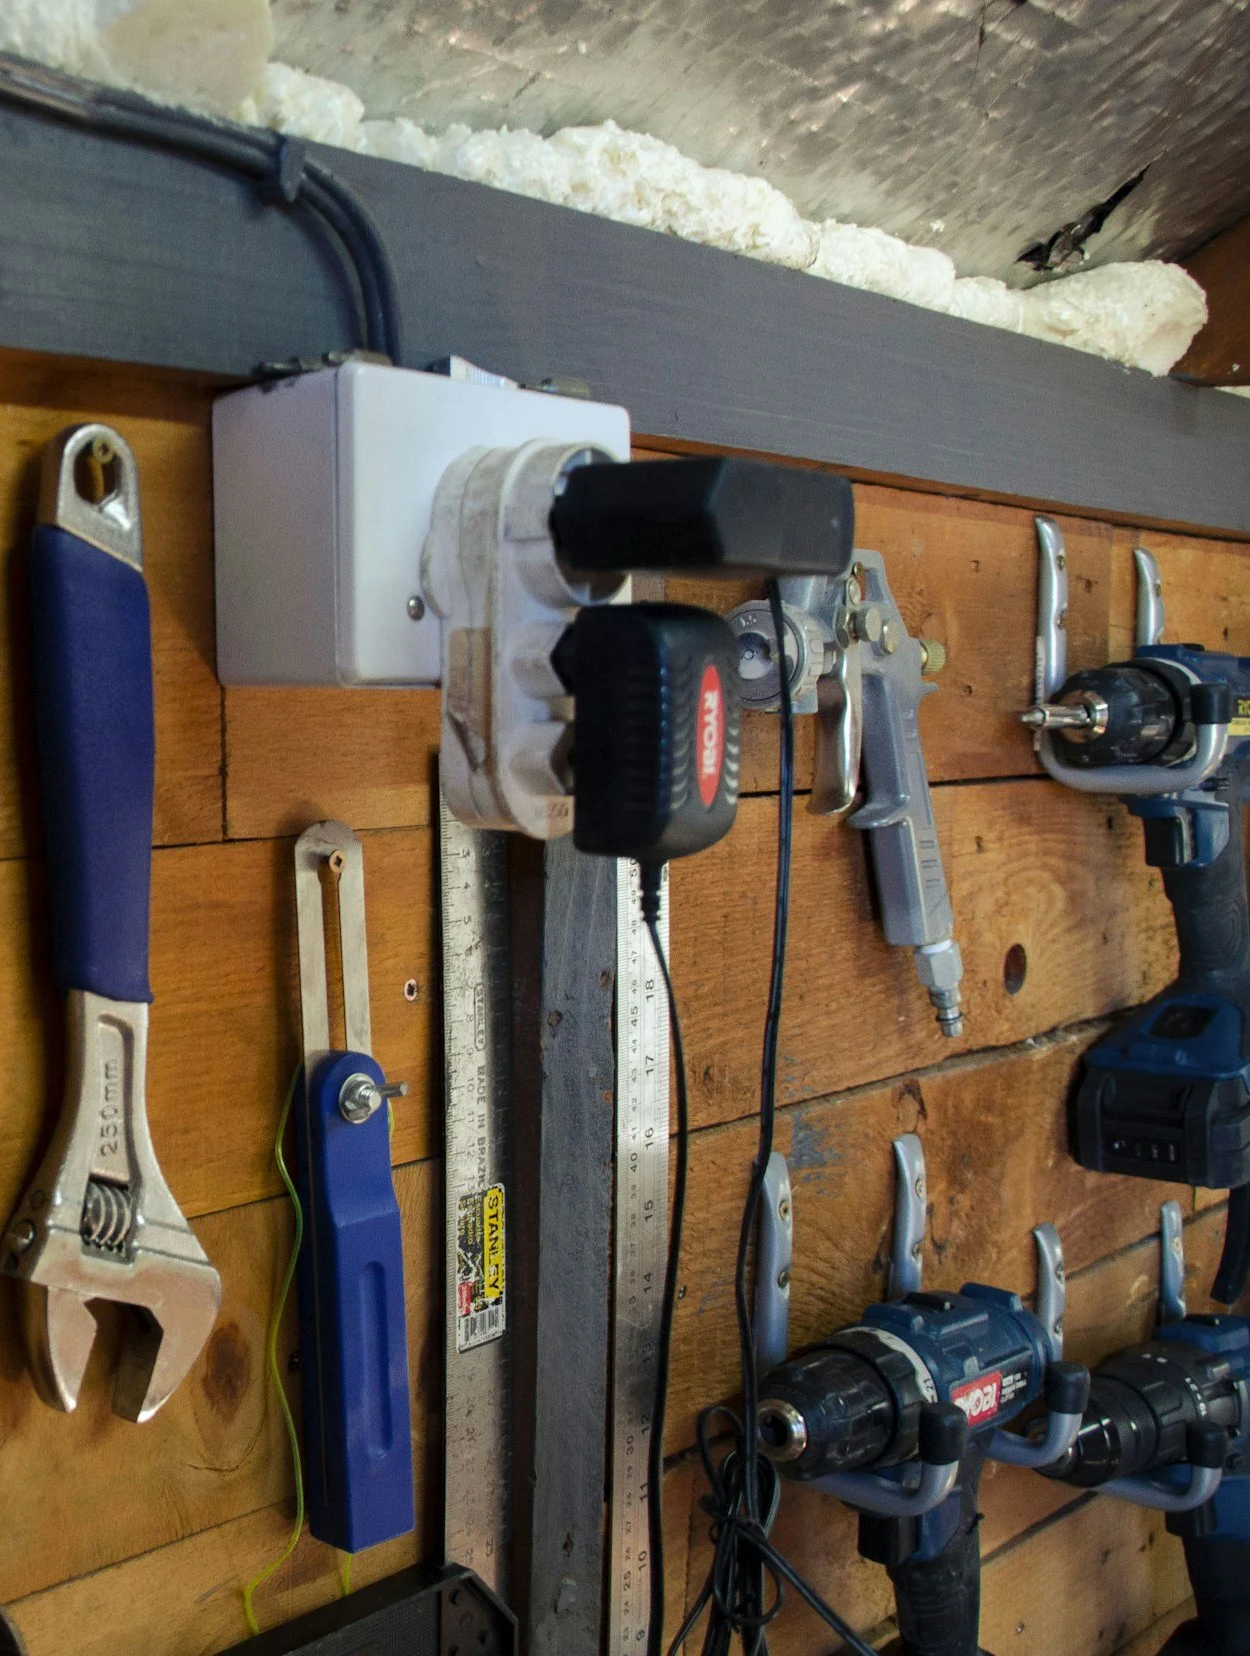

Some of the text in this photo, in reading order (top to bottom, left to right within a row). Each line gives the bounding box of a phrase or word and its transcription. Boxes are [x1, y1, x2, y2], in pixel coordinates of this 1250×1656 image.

[702, 690, 718, 779] RYOBI
[631, 951, 637, 965] 47
[645, 978, 655, 1002] 18
[630, 1005, 639, 1027] 45
[645, 1054, 654, 1077] 17
[476, 1065, 486, 1104] MADE
[99, 1059, 119, 1158] 250mm
[631, 1096, 638, 1112] 42
[477, 1114, 486, 1129] IN
[631, 1127, 637, 1141] 41
[644, 1127, 654, 1149] 16
[630, 1152, 638, 1173] 40
[644, 1199, 654, 1222] 15
[487, 1194, 500, 1291] STANLEY
[643, 1272, 653, 1294] 14
[640, 1414, 650, 1436] 12
[626, 1435, 634, 1456] 30
[638, 1550, 647, 1571] 10
[623, 1571, 631, 1591] 25
[636, 1629, 646, 1642] 9
